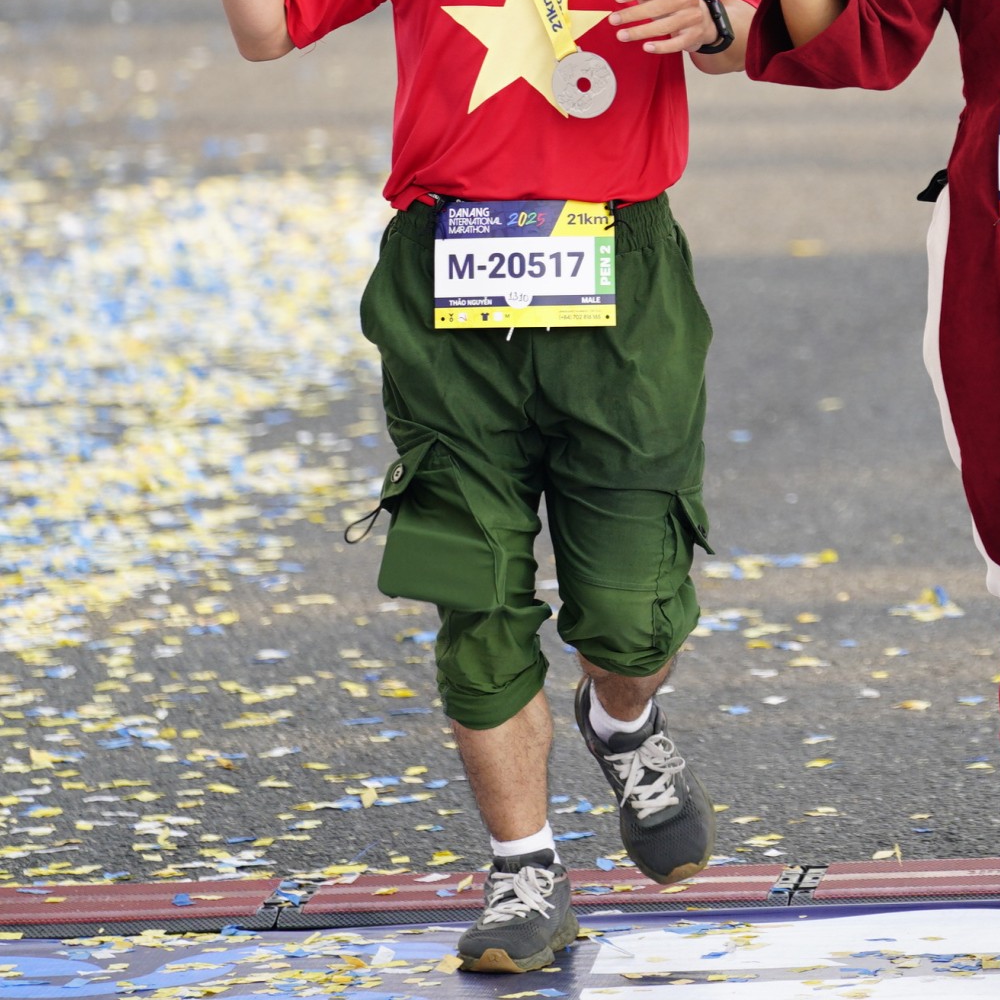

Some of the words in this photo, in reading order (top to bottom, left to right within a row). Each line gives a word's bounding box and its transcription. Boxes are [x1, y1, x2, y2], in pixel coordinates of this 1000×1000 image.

[449, 208, 490, 218] DANANG
[506, 211, 546, 227] 2025
[567, 213, 609, 225] 21km
[449, 217, 503, 226] INTERNATIONAL
[448, 225, 490, 234] MARATHON
[600, 245, 611, 254] 2
[448, 251, 585, 280] M-20517
[600, 257, 611, 286] PEN
[581, 296, 601, 304] MALE
